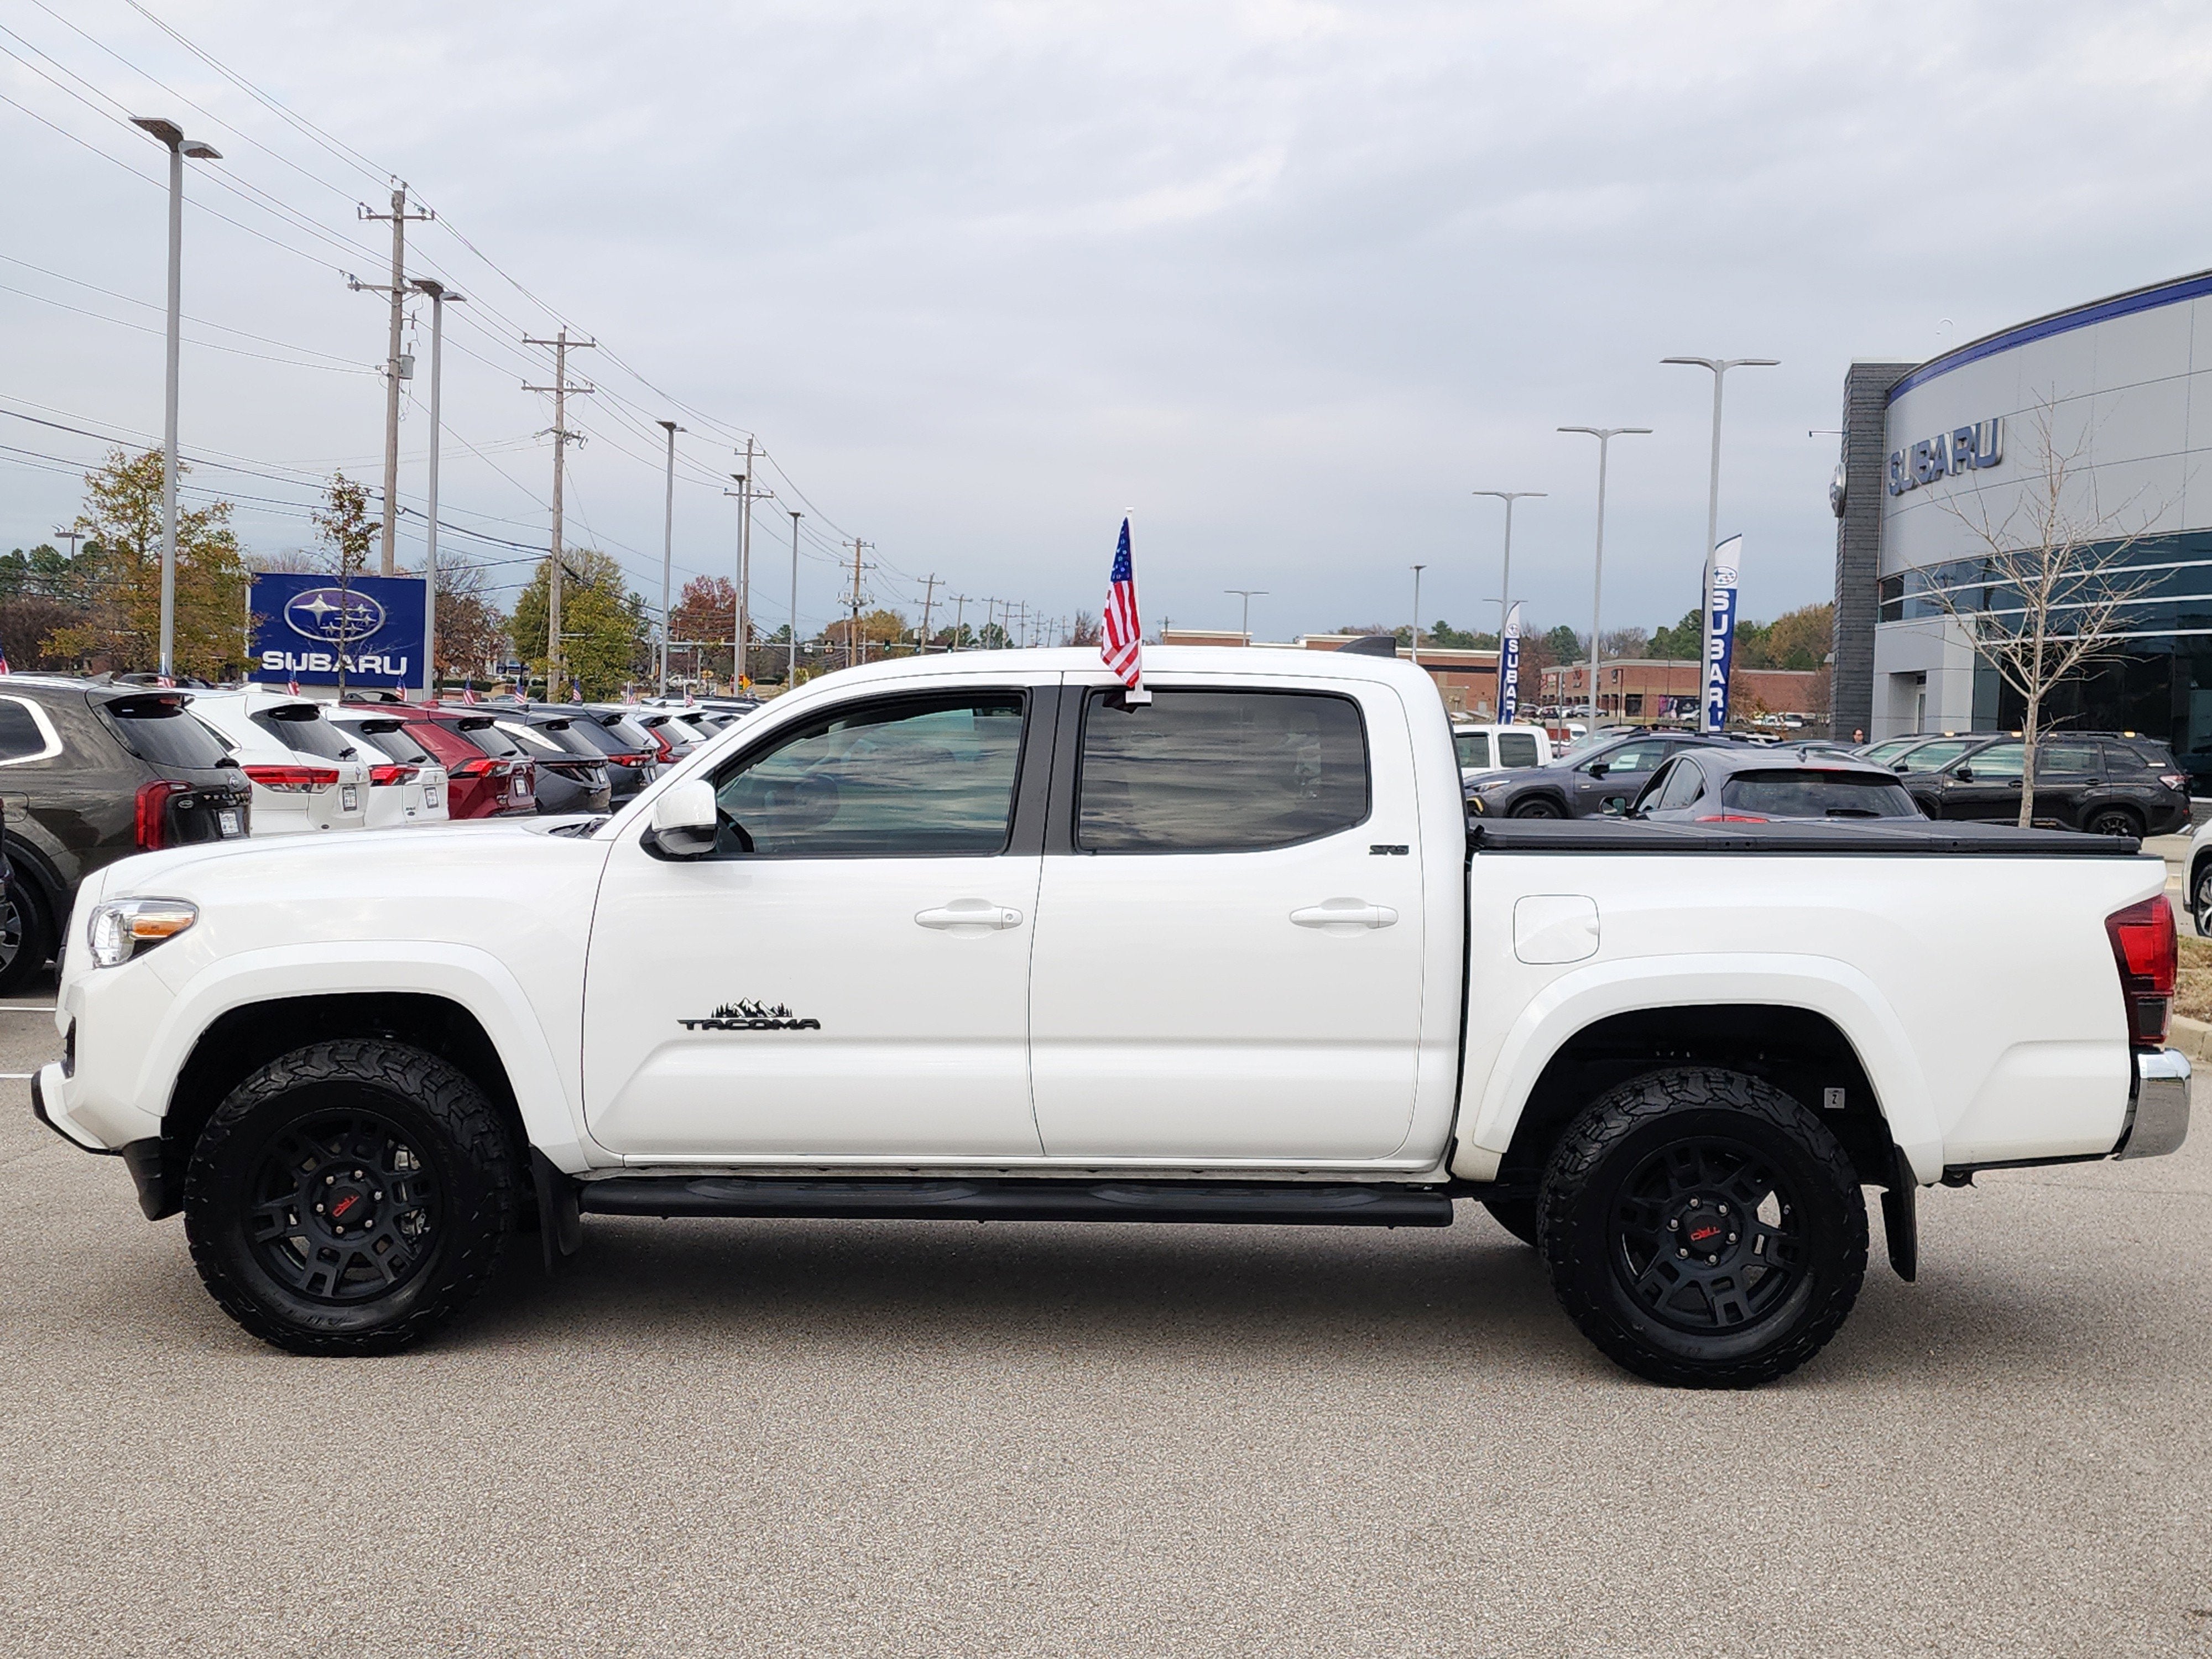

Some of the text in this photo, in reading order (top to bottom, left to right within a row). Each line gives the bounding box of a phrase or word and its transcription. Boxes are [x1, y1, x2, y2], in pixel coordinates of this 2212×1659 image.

[1888, 418, 2005, 496] SUBARU
[262, 651, 408, 675] SUBARU
[676, 1019, 821, 1031] TACOMA
